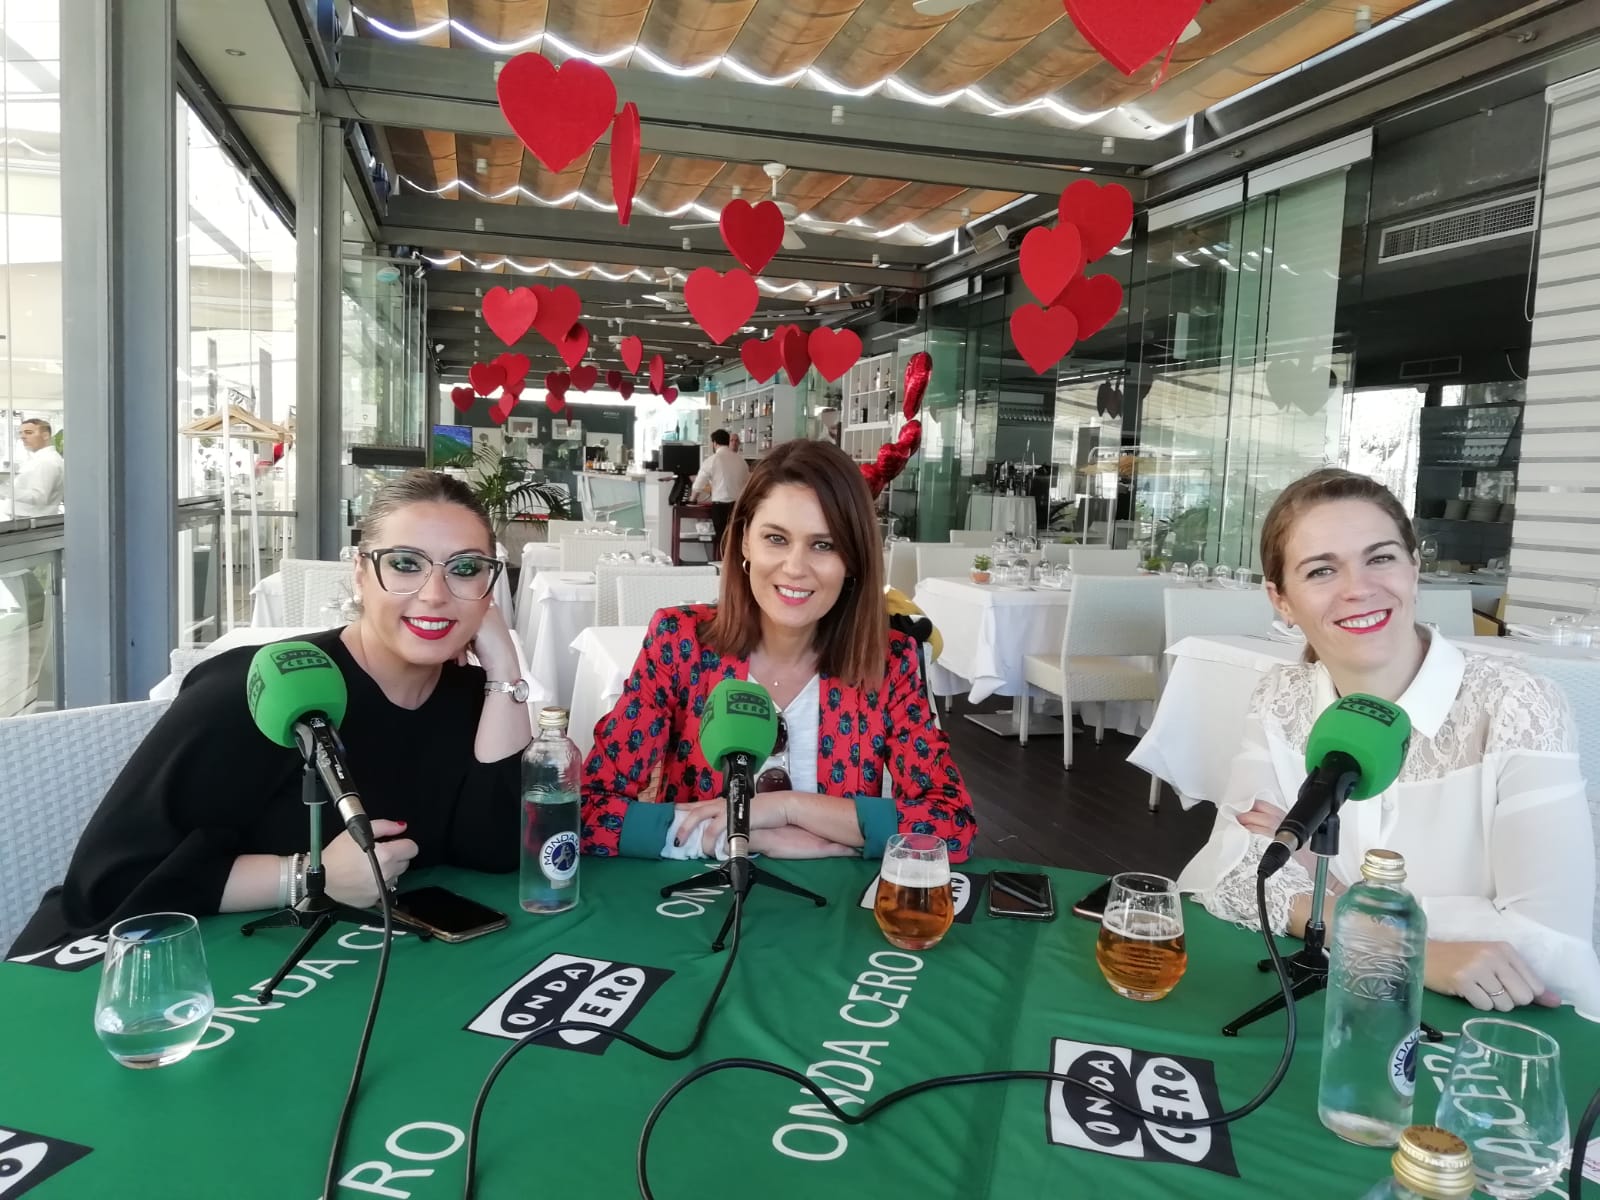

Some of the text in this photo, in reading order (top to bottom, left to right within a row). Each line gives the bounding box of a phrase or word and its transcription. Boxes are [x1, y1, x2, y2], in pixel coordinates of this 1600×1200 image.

[735, 703, 765, 714] CERO
[506, 968, 588, 1026] ONDA
[574, 975, 638, 1022] ERO
[772, 951, 924, 1161] ONDA CERO
[1085, 1060, 1121, 1135] ONDA
[1151, 1064, 1198, 1144] CERO
